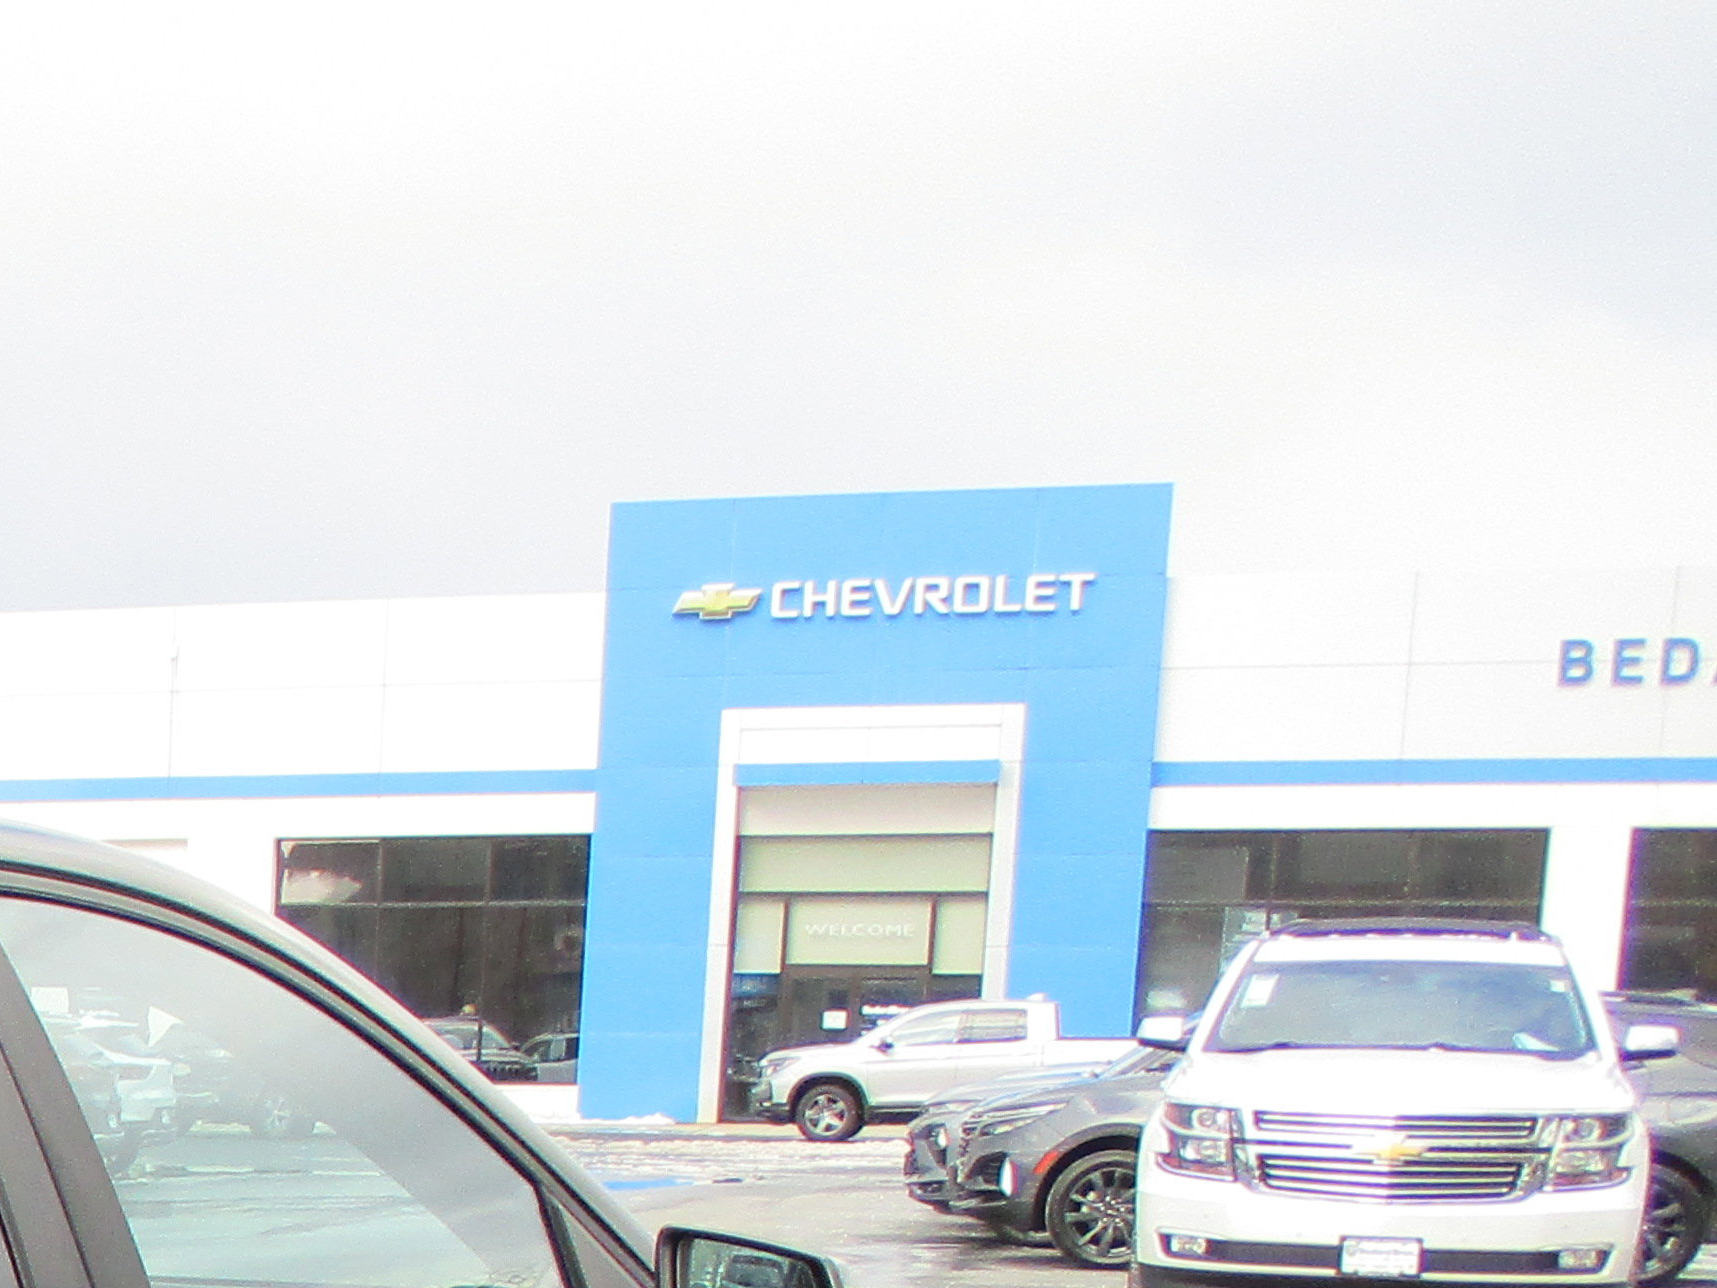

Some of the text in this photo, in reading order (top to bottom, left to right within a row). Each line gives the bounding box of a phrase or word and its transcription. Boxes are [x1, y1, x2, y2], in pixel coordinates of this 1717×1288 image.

[769, 571, 1096, 618] CHEVROLET
[1558, 636, 1717, 687] BED
[804, 923, 915, 937] WELCOME
